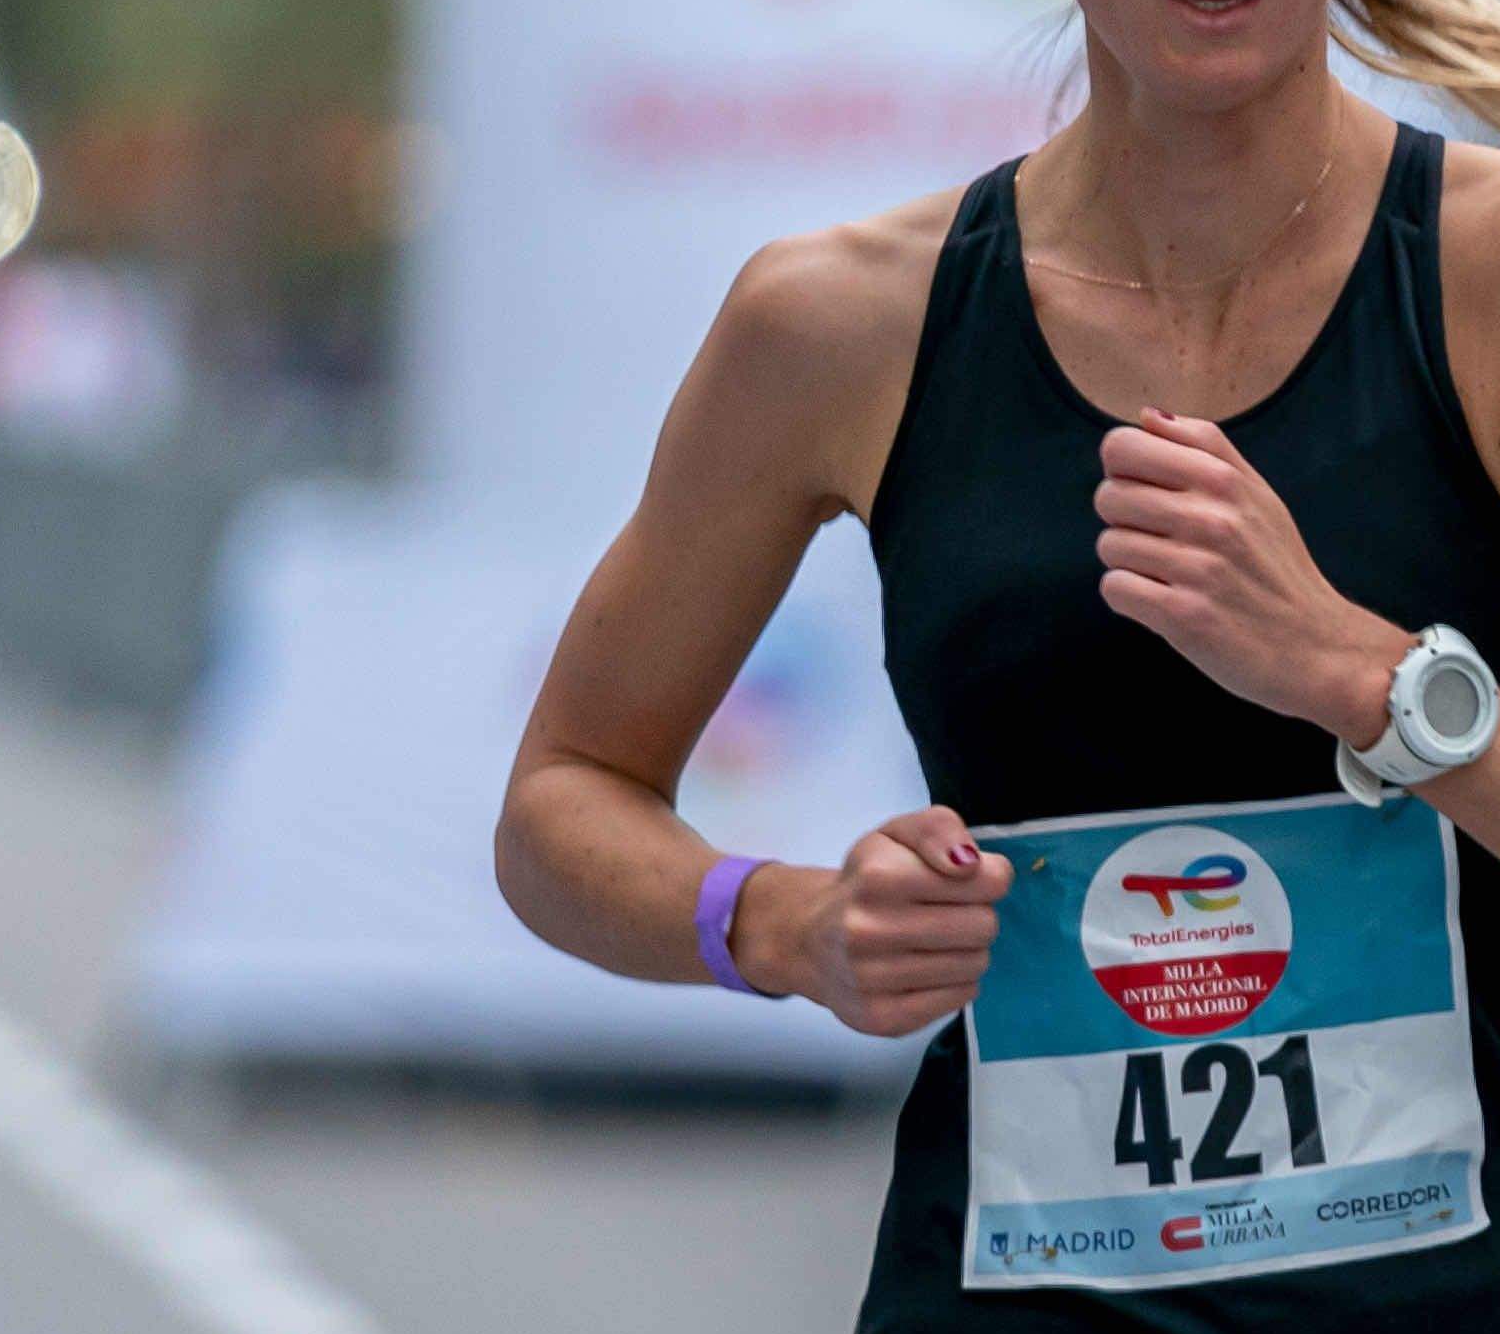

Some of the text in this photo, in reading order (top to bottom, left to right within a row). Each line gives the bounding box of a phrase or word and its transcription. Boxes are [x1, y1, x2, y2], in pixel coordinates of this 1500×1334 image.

[1129, 920, 1255, 948] TotalEnergies
[1162, 961, 1223, 981] MILLA
[1122, 975, 1267, 1005] INTERNACIONAL
[1145, 996, 1248, 1022] DE MADRID
[1114, 1035, 1326, 1187] 421
[1207, 1203, 1274, 1227] MILLA
[1027, 1228, 1135, 1253] MADRID
[1209, 1221, 1288, 1248] URBANA
